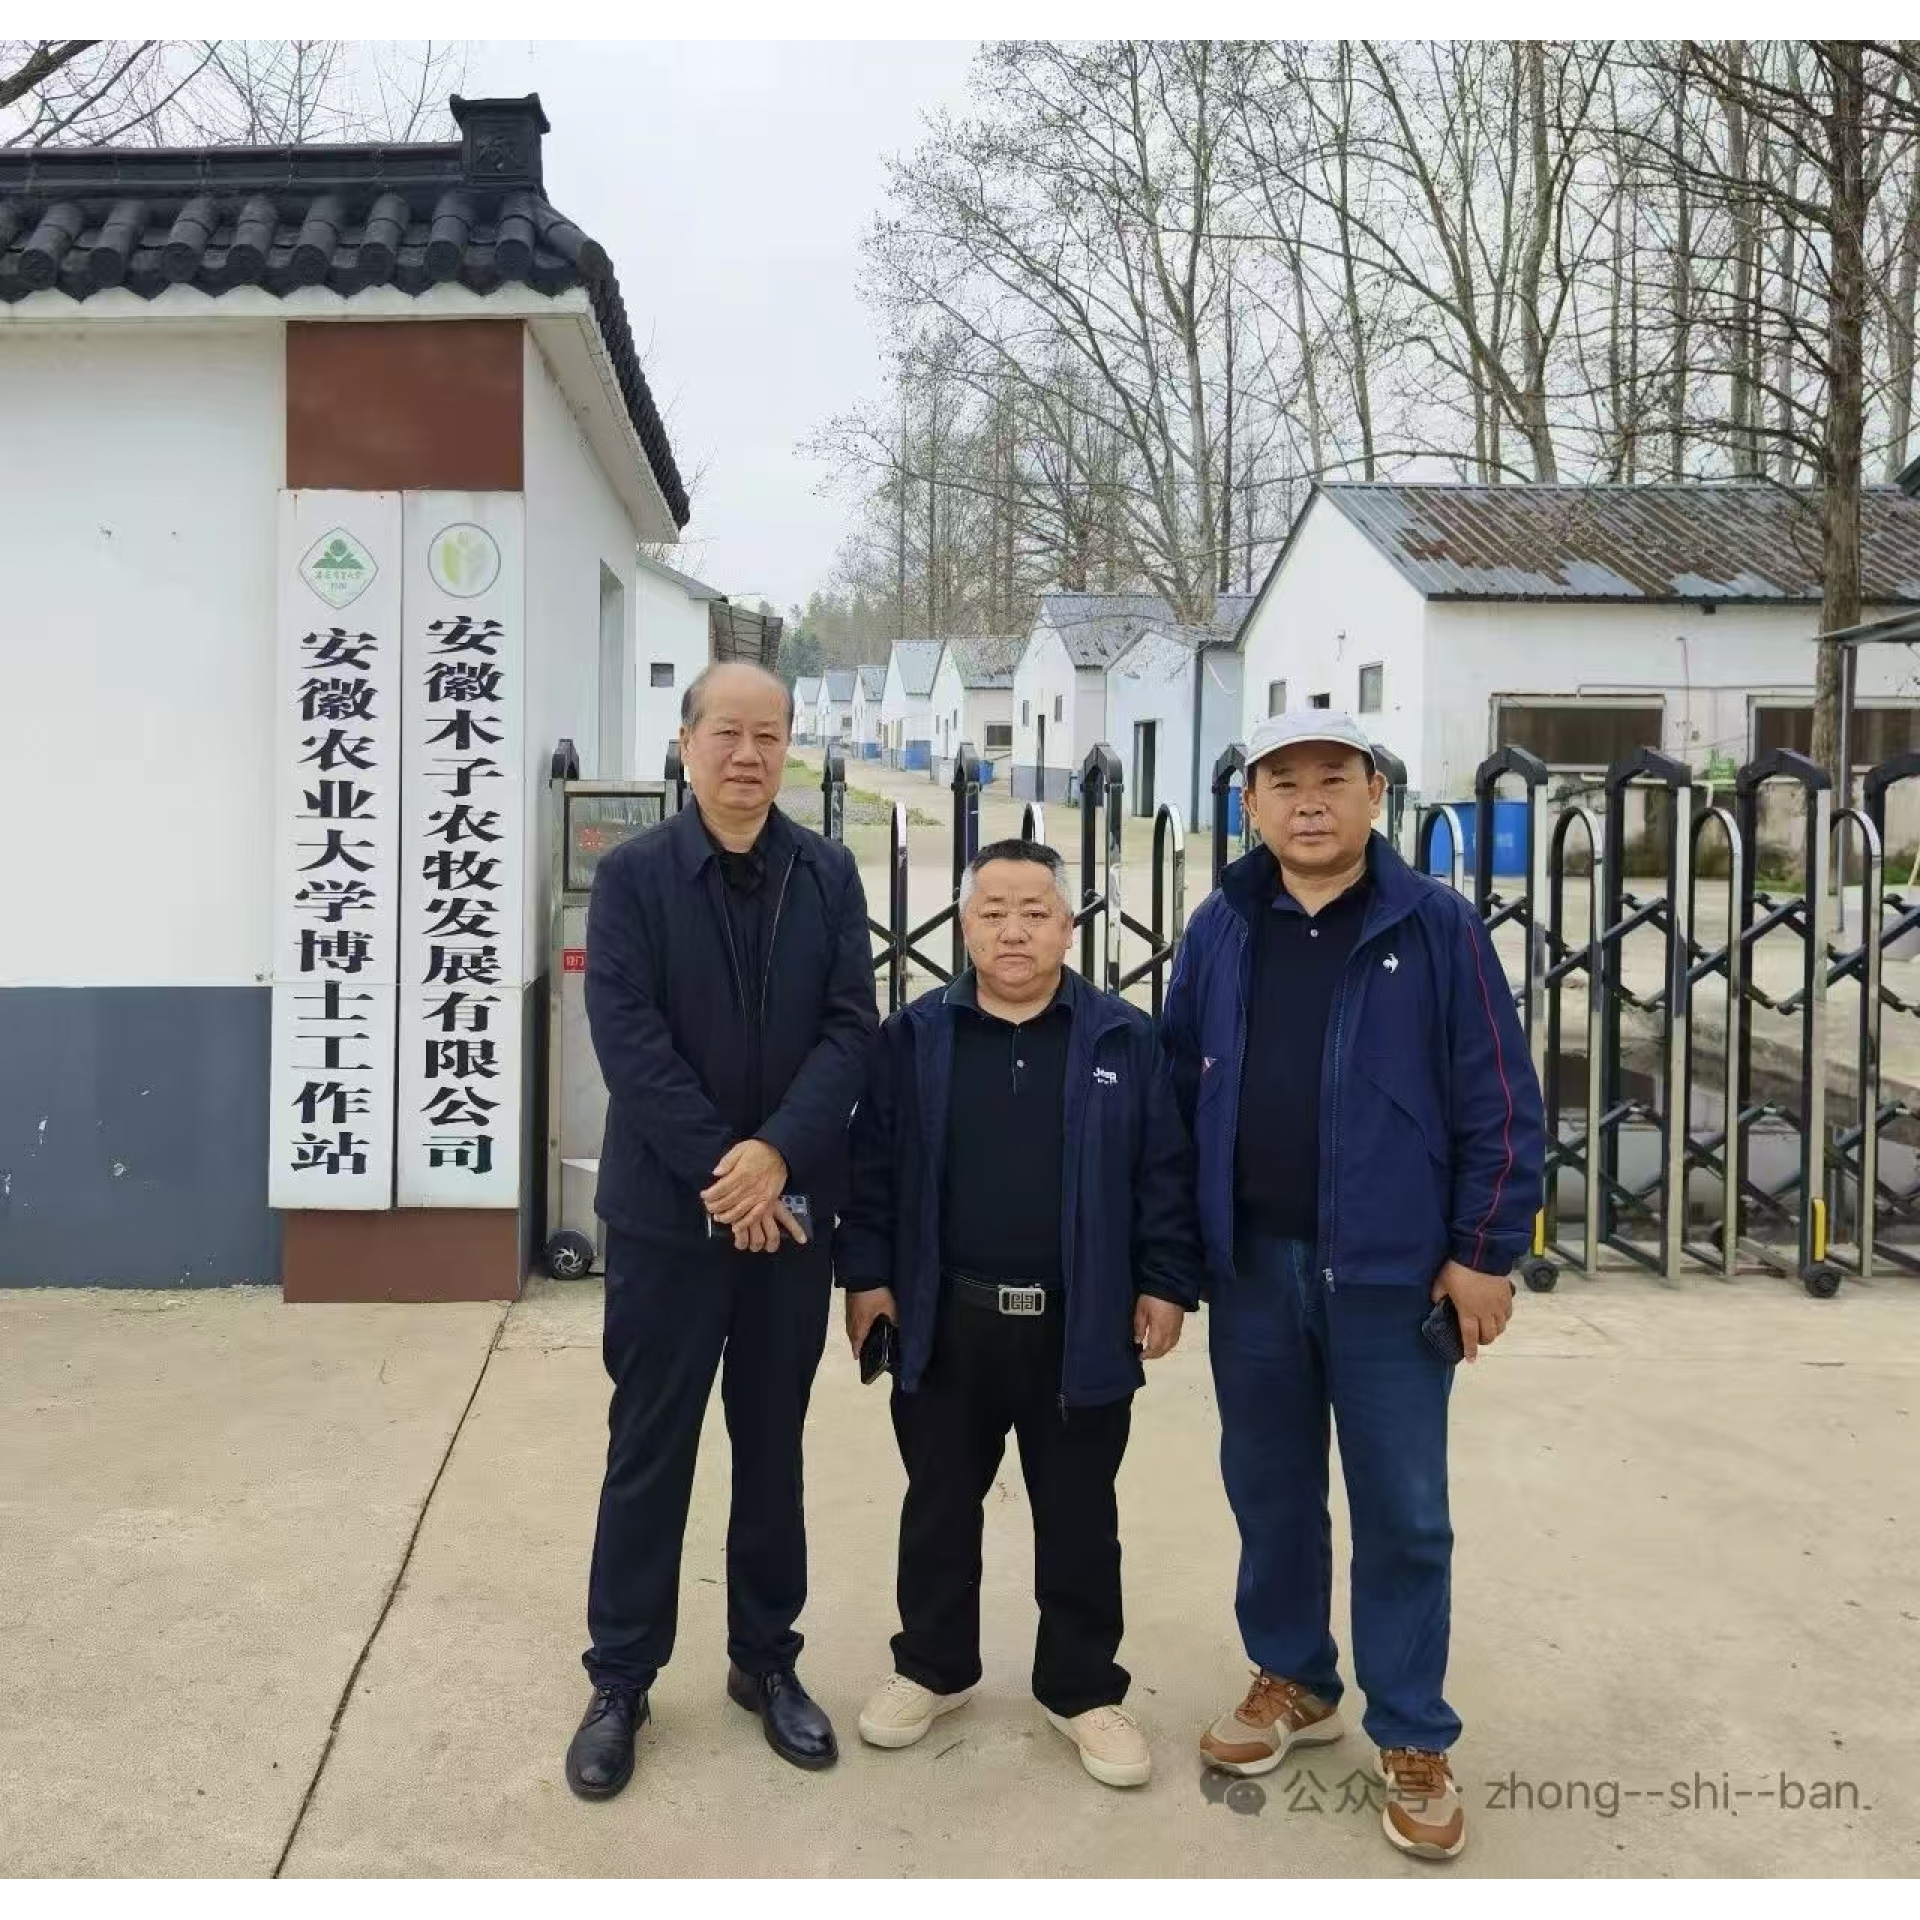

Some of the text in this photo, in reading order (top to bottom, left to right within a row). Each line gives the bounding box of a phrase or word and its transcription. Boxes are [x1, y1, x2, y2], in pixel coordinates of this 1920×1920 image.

[290, 627, 379, 1175] 安徽农业大学博士工作站
[420, 615, 505, 1175] 安徽木子农牧发展有限公司
